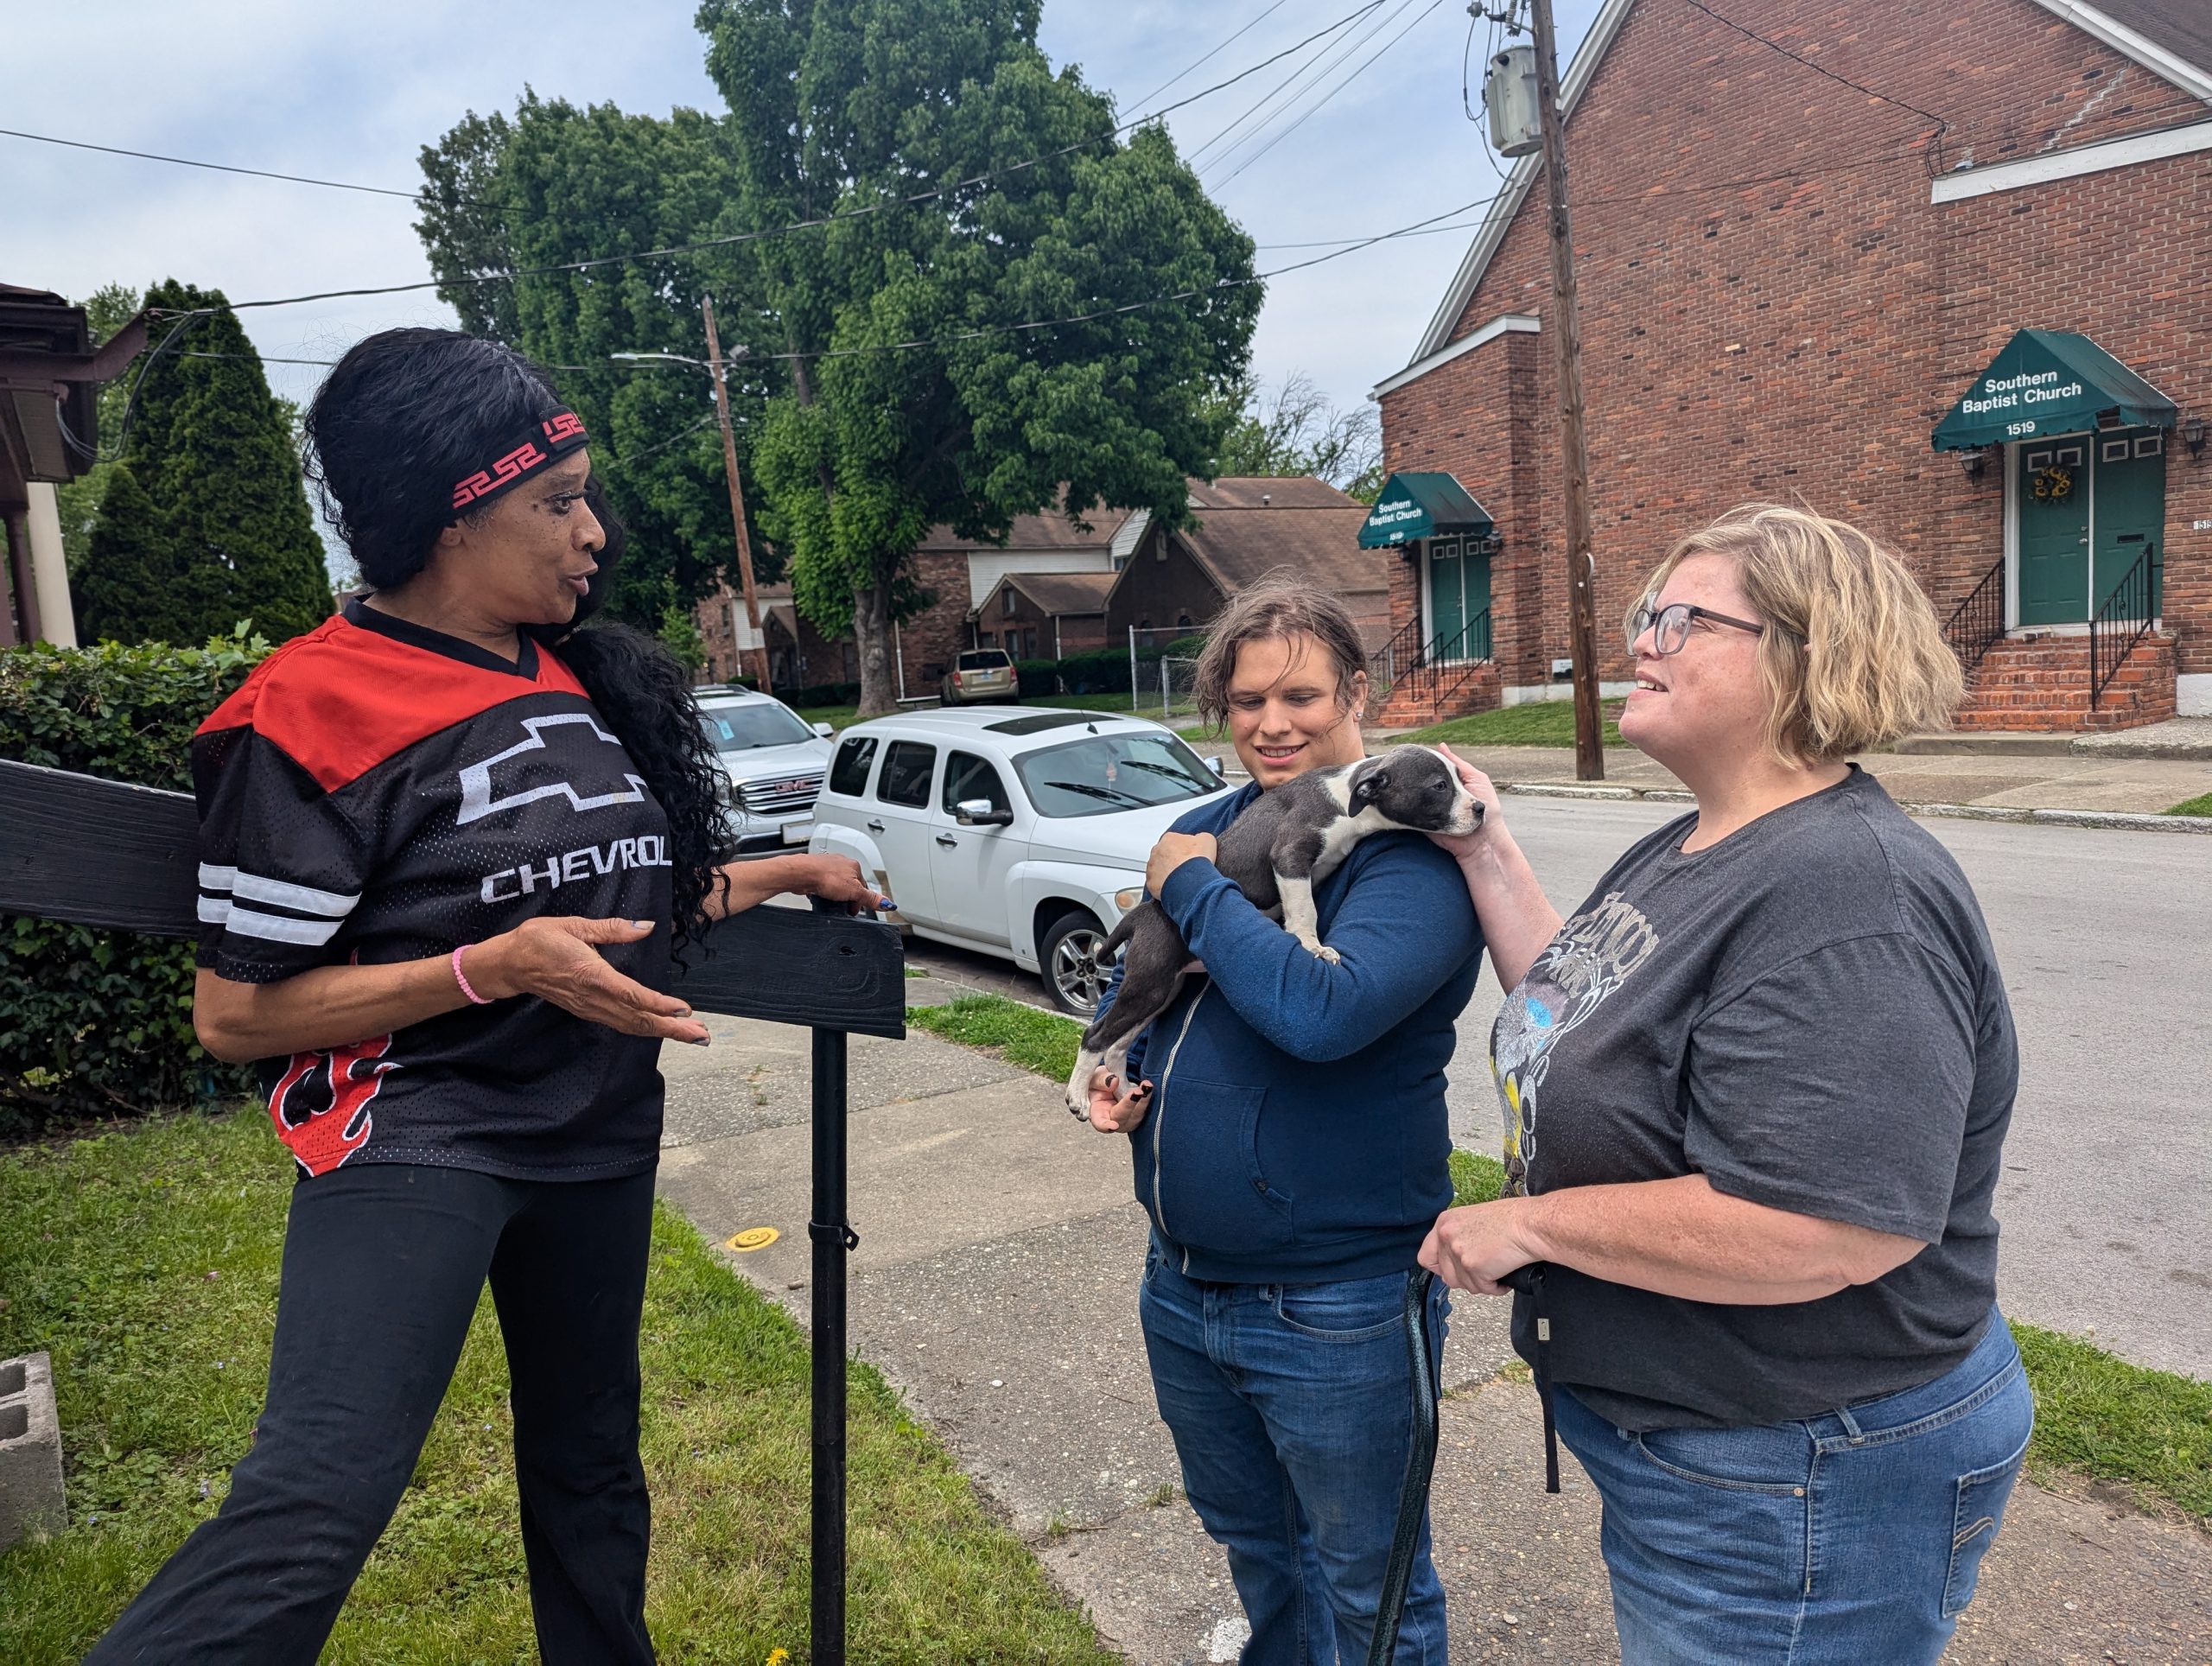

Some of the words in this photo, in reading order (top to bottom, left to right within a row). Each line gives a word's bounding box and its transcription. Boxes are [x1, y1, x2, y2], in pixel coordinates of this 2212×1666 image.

[1985, 371, 2057, 393] Southern
[1962, 393, 2018, 413] Baptist
[2024, 382, 2082, 403] Church
[2006, 421, 2036, 436] 1519
[1378, 500, 1411, 513] Southern
[1369, 514, 1395, 526] Baptist
[1395, 508, 1421, 520] Church
[1389, 531, 1404, 541] 1519
[775, 779, 815, 792] GMC
